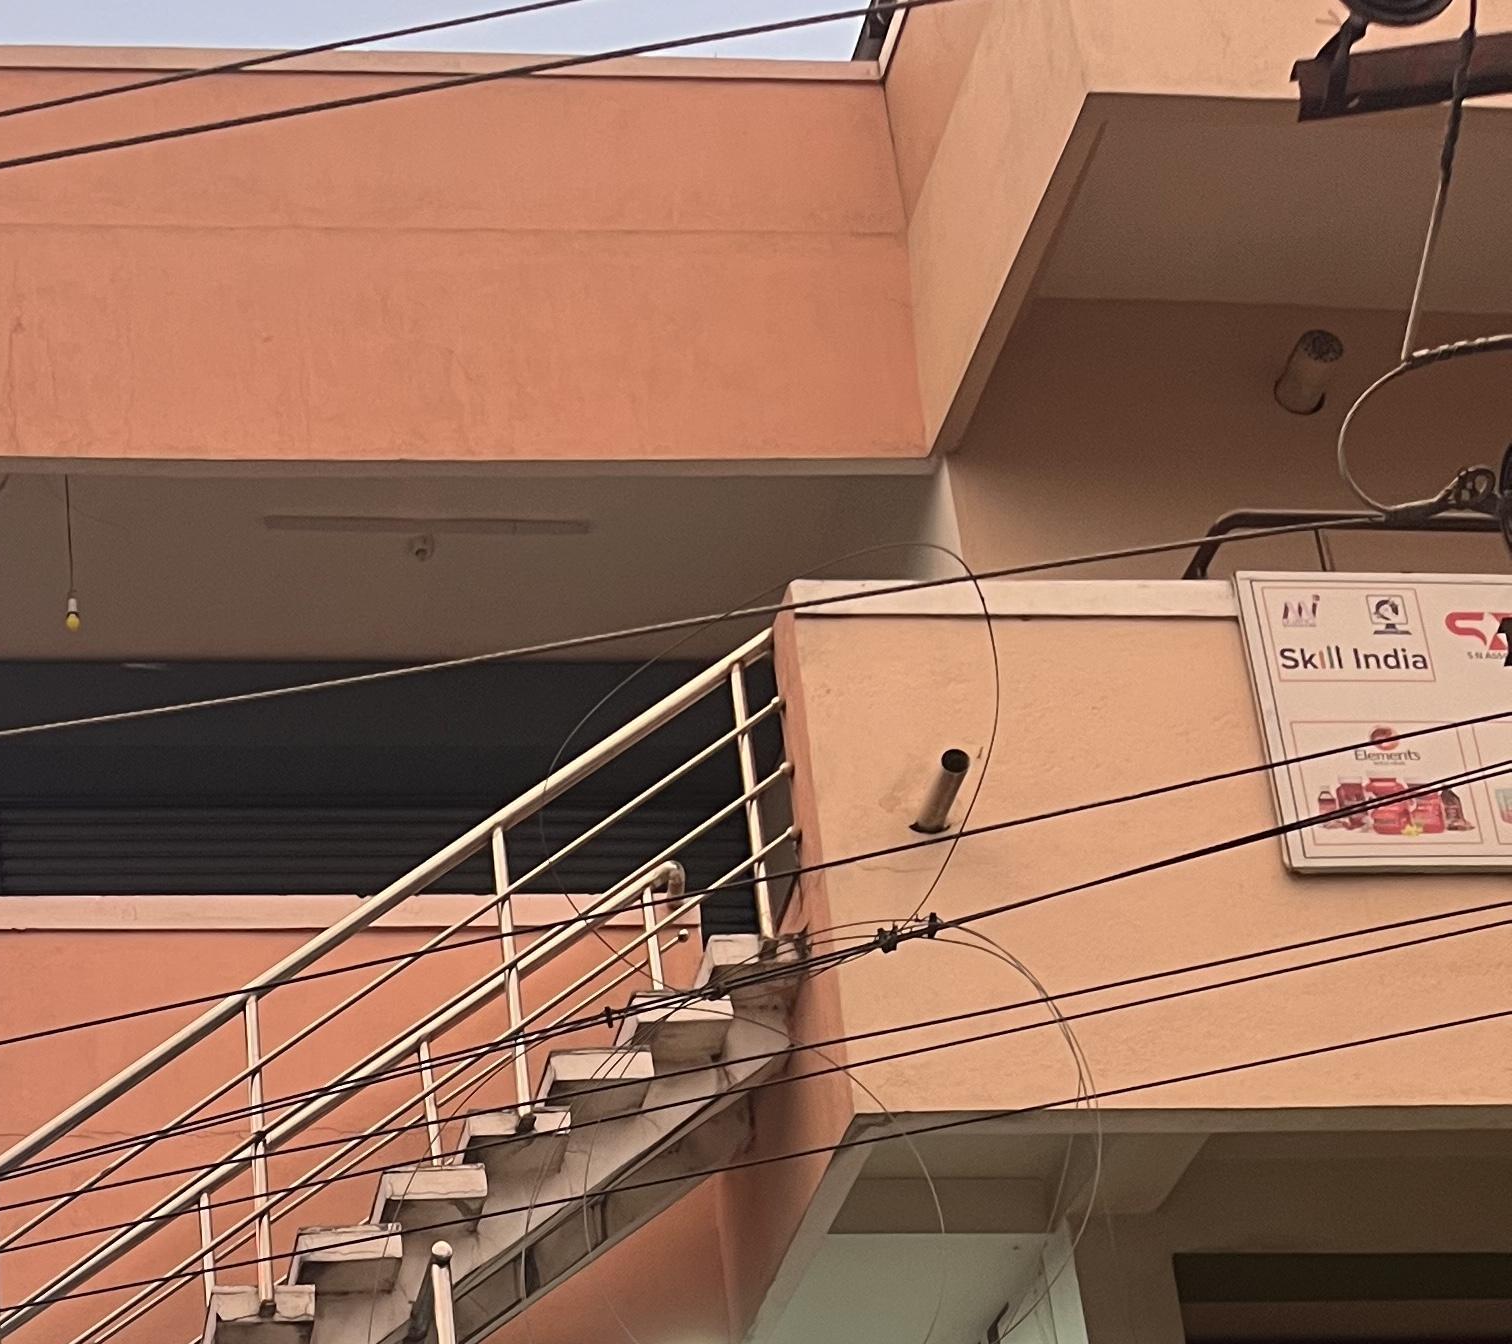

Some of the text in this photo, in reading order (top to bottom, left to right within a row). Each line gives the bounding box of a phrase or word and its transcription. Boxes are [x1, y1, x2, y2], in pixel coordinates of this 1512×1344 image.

[1279, 645, 1429, 670] Skill India
[1354, 749, 1421, 762] Elements
